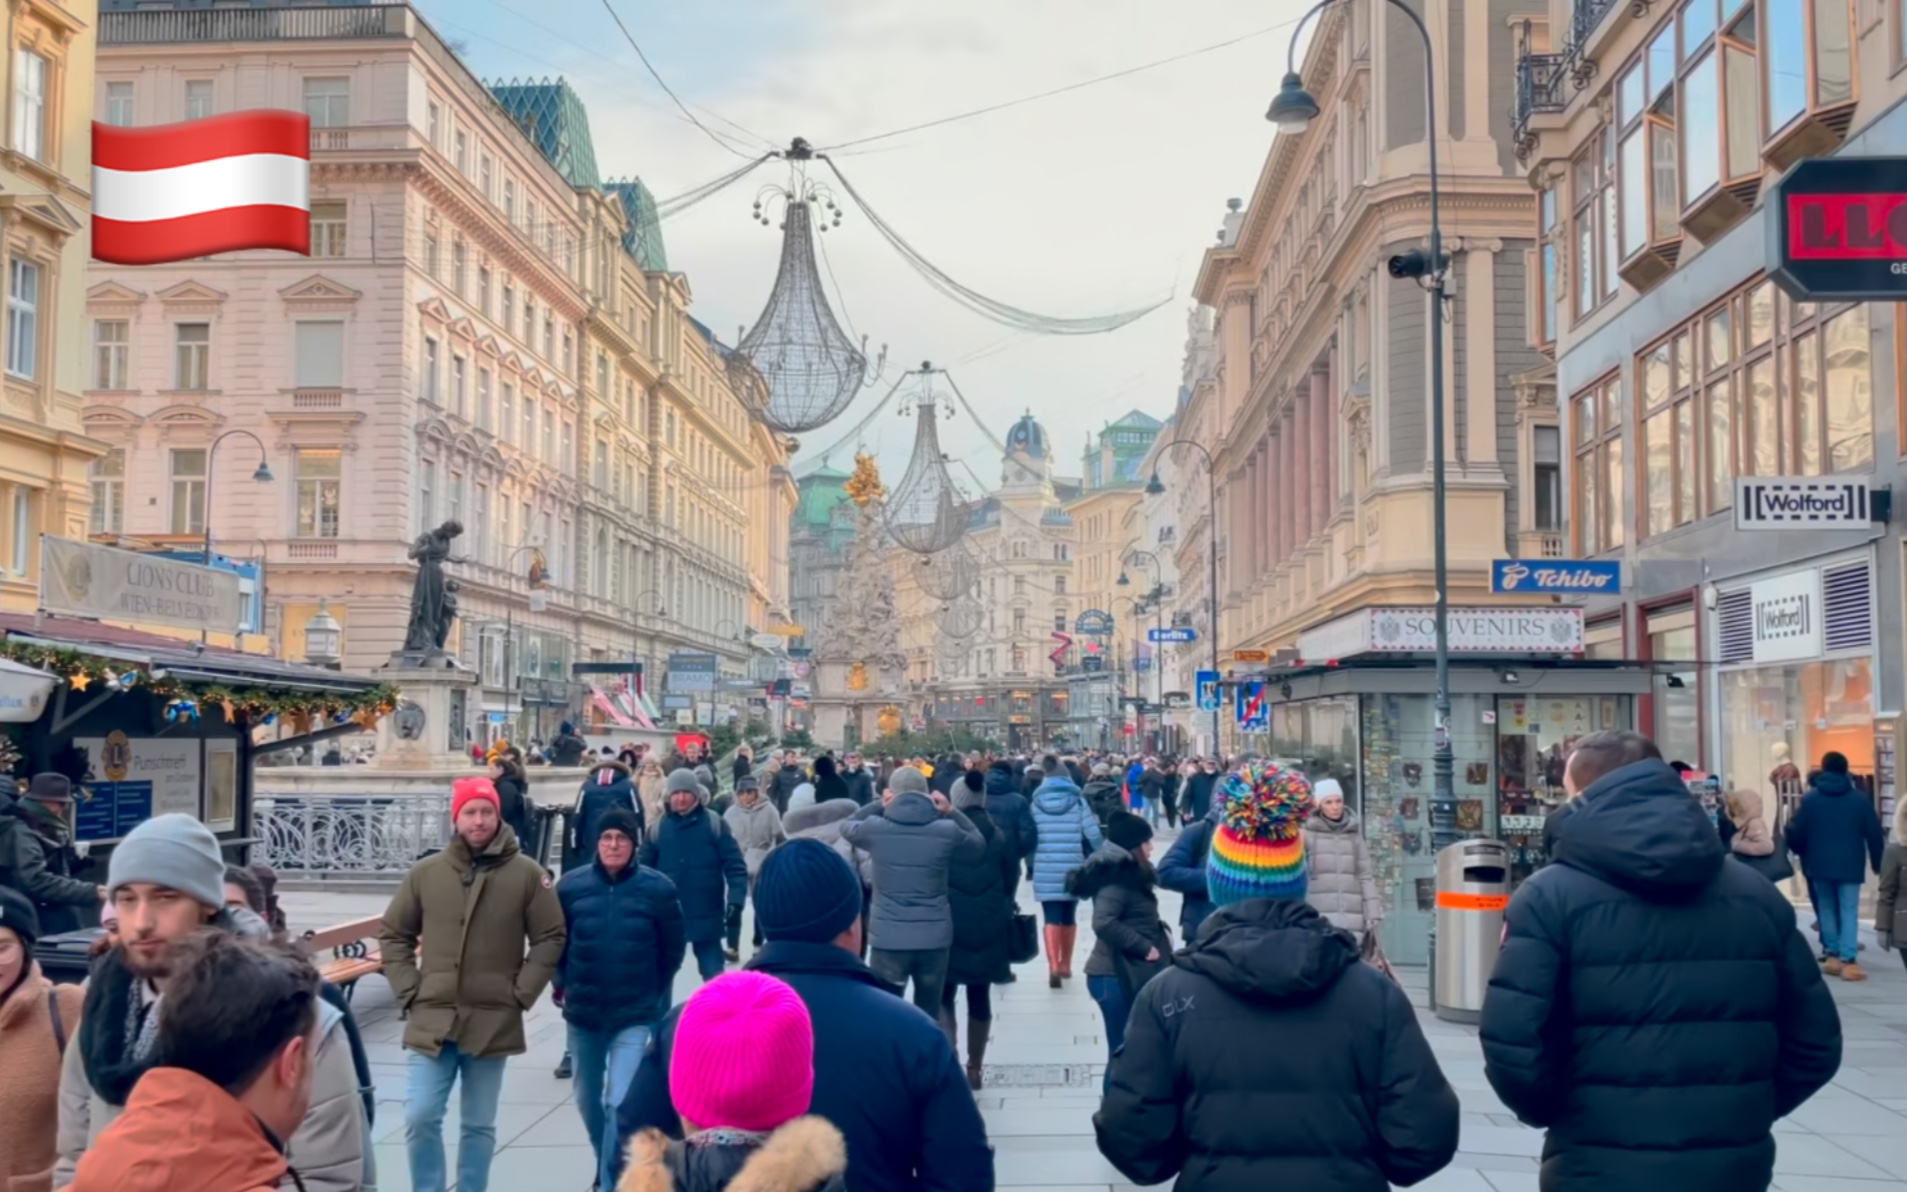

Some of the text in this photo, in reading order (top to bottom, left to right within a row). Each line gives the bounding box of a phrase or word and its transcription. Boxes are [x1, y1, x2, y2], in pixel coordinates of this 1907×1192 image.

[1764, 493, 1845, 512] Wolford
[126, 562, 215, 597] LIONS CLUB
[1533, 569, 1614, 587] Tchibo
[1764, 604, 1800, 629] Wolford
